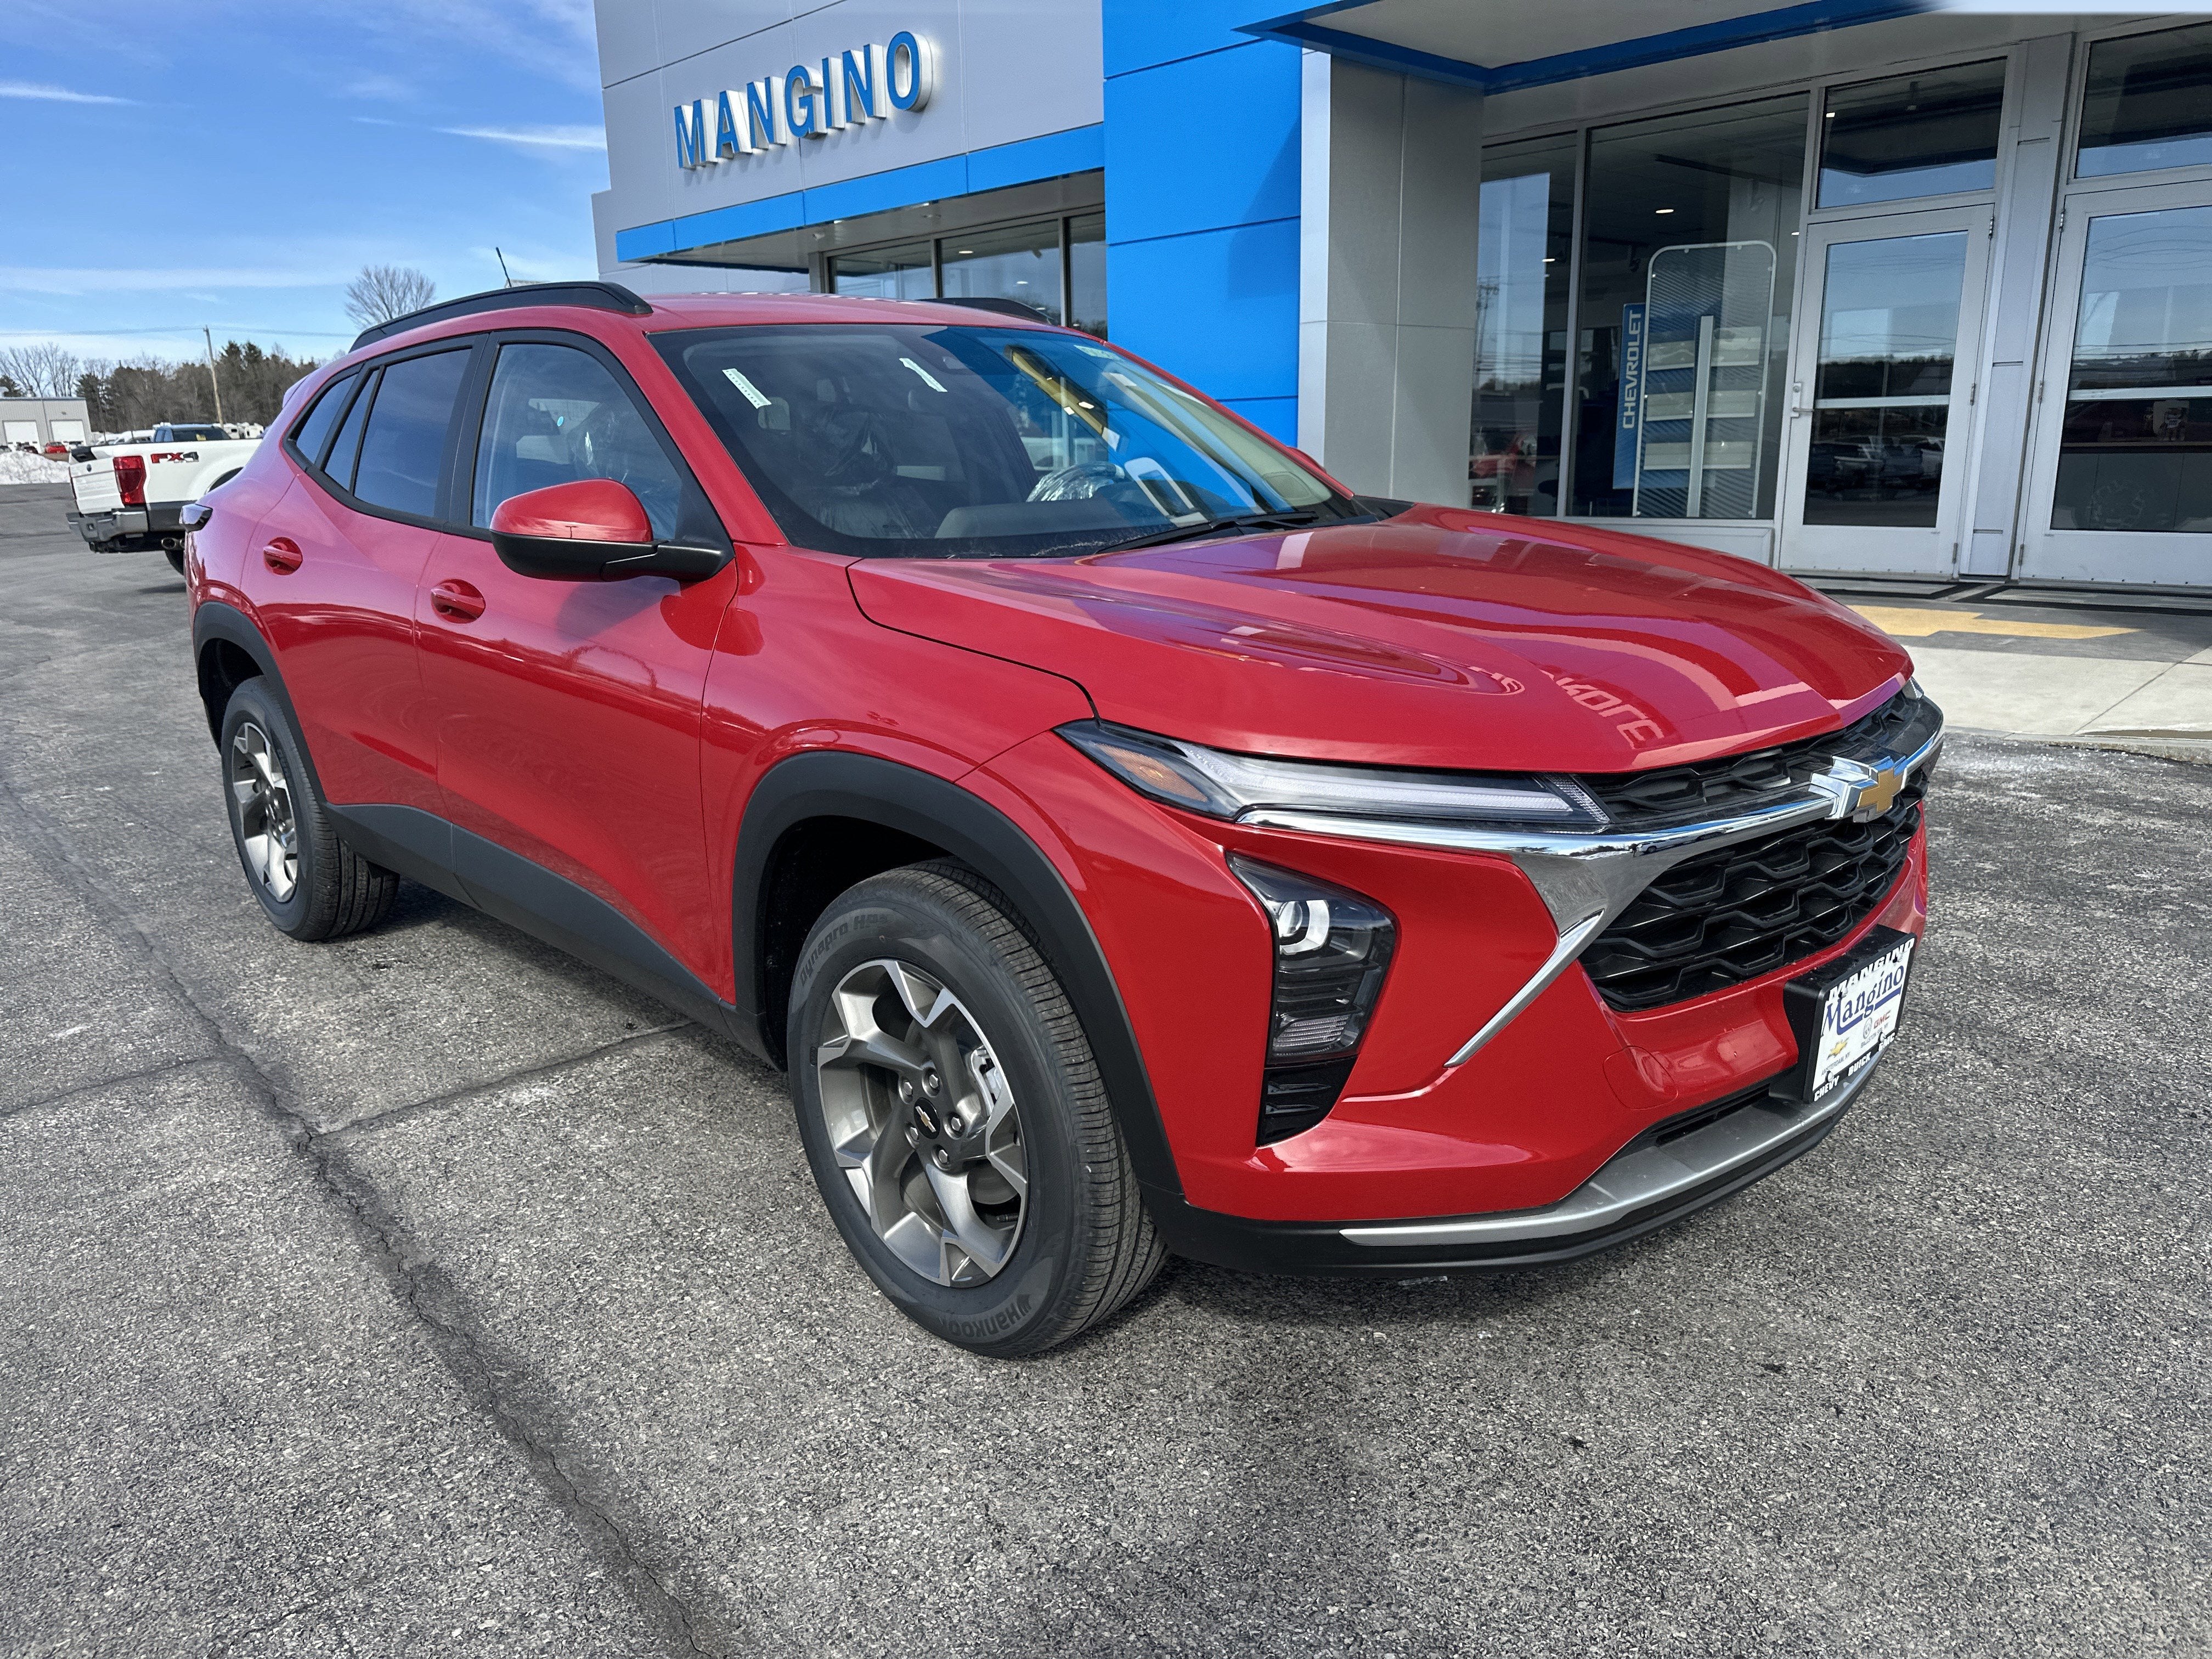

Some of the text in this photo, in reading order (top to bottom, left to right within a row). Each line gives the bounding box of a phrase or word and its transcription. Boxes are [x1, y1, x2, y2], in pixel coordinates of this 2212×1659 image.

[674, 31, 932, 170] MANGINO
[1622, 309, 1641, 429] CHEVROLET
[150, 452, 200, 464] FX4
[1820, 965, 1904, 1036] Mangino
[1874, 1010, 1892, 1029] GMC
[1814, 1032, 1896, 1102] CHEVY BUICK GMC
